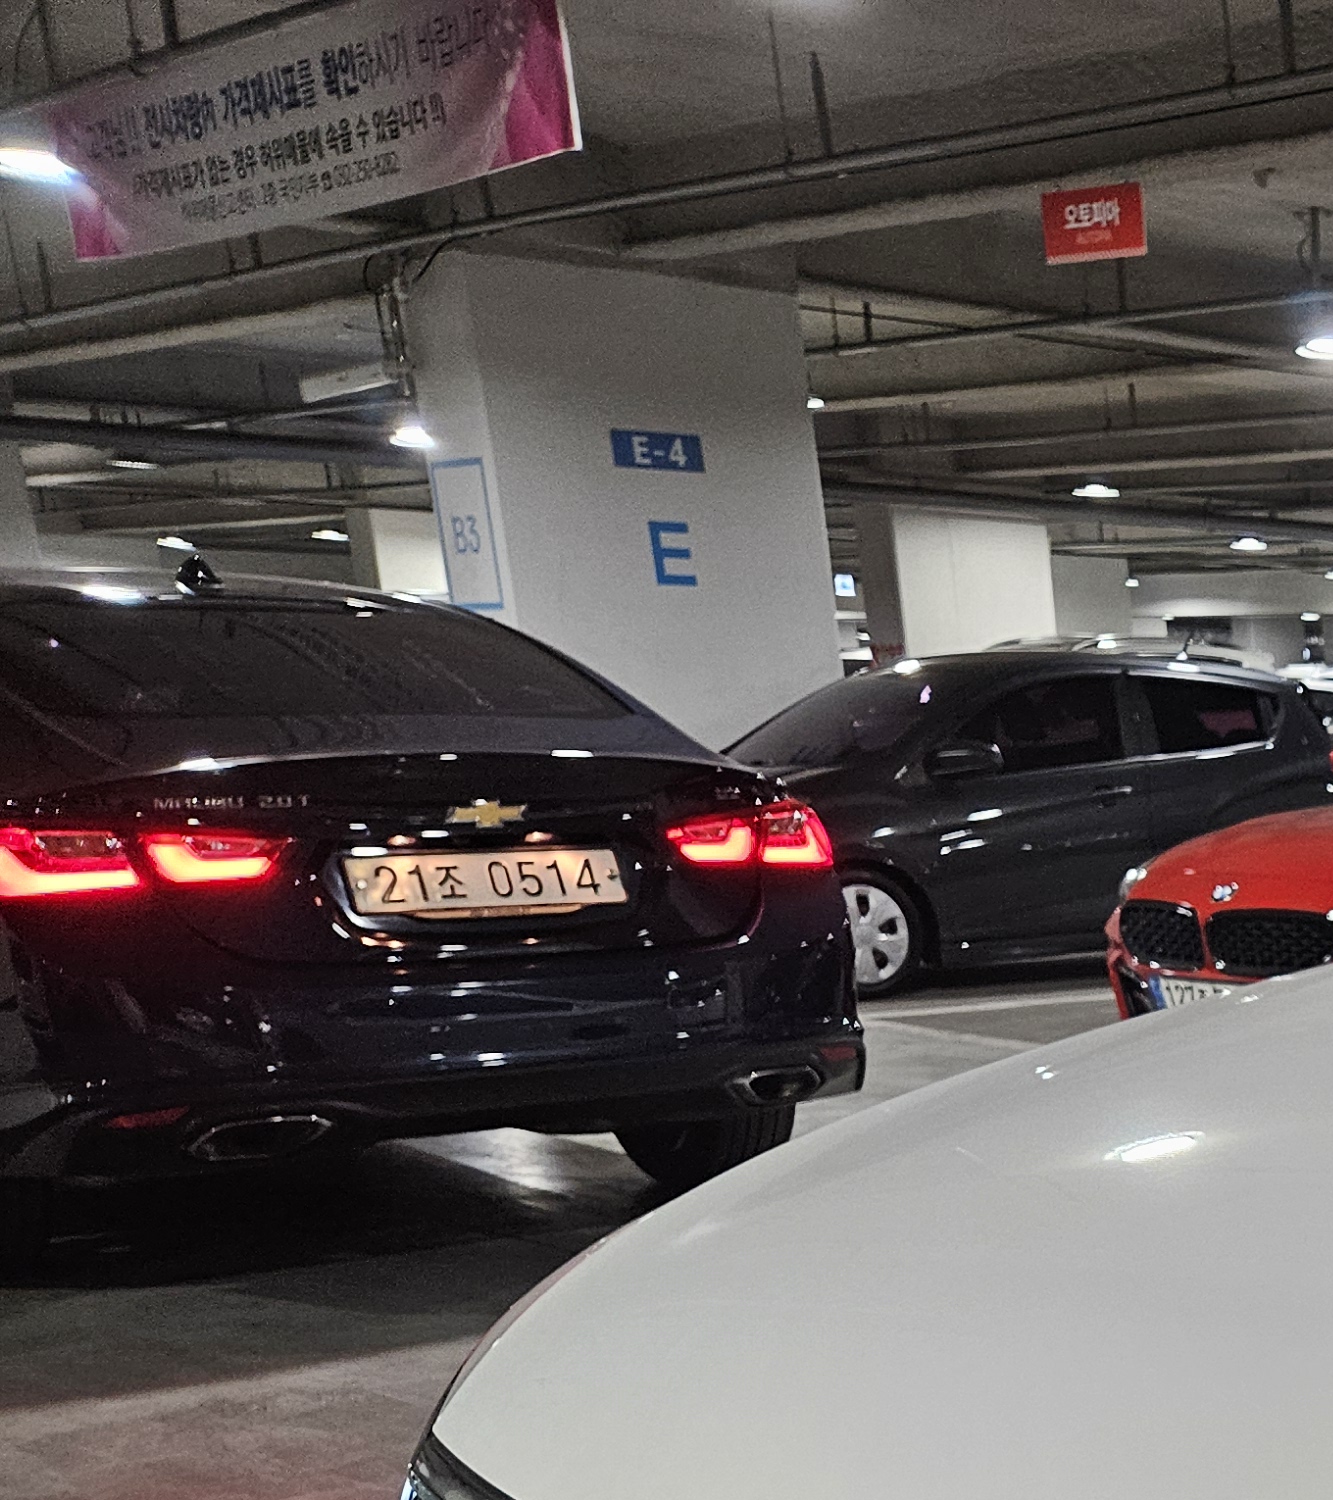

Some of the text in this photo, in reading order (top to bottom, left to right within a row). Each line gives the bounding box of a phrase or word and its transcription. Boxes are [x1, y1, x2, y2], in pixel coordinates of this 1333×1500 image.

[322, 27, 411, 101] 확인하시기
[233, 144, 258, 180] 경우
[325, 117, 354, 158] 속을
[356, 113, 370, 150] 수
[631, 435, 689, 468] E-4
[450, 514, 482, 555] B3
[647, 520, 699, 587] E
[373, 858, 602, 904] 21조 0514
